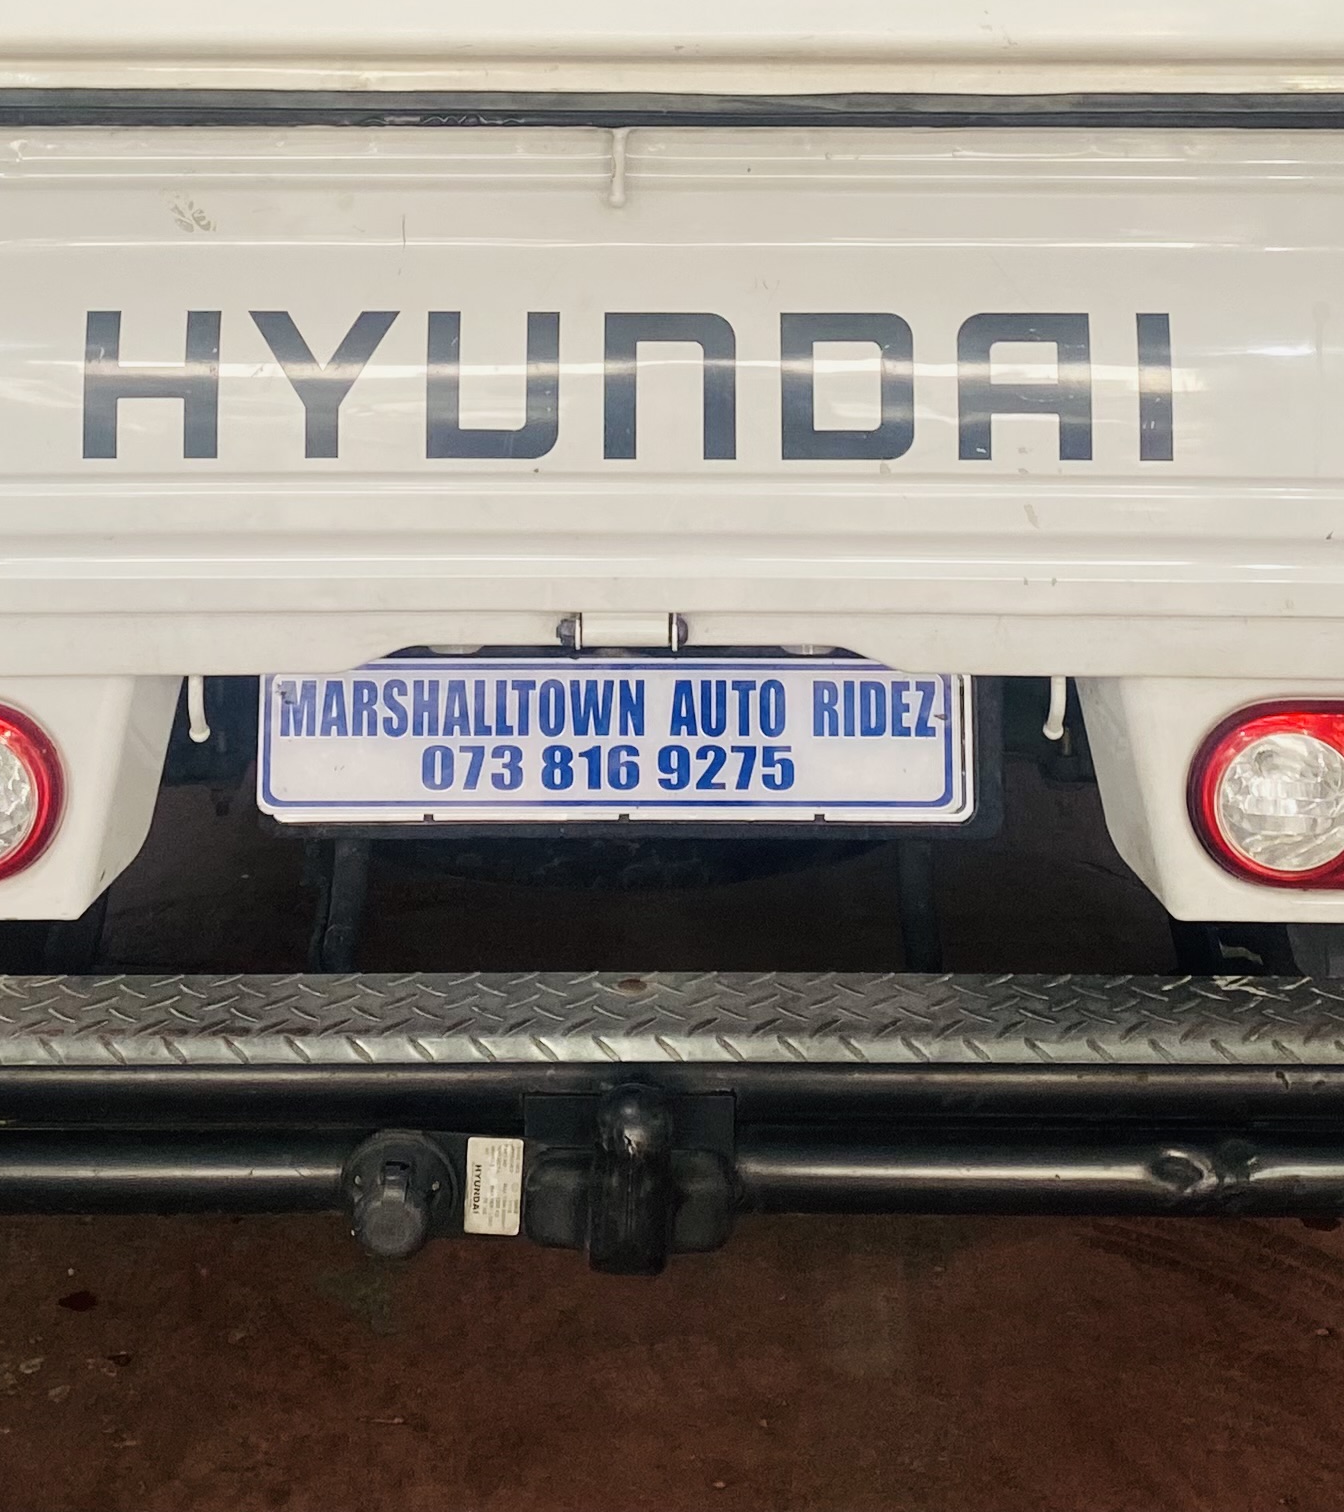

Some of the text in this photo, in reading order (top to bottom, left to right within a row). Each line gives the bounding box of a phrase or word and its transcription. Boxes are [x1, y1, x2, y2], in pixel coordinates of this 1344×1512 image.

[82, 309, 1174, 461] HYUNDAI
[278, 678, 937, 739] MARSHALLTOWN AUTO RIDEZ
[420, 744, 796, 791] 073 816 9275
[472, 1164, 483, 1215] HYUNDAI
